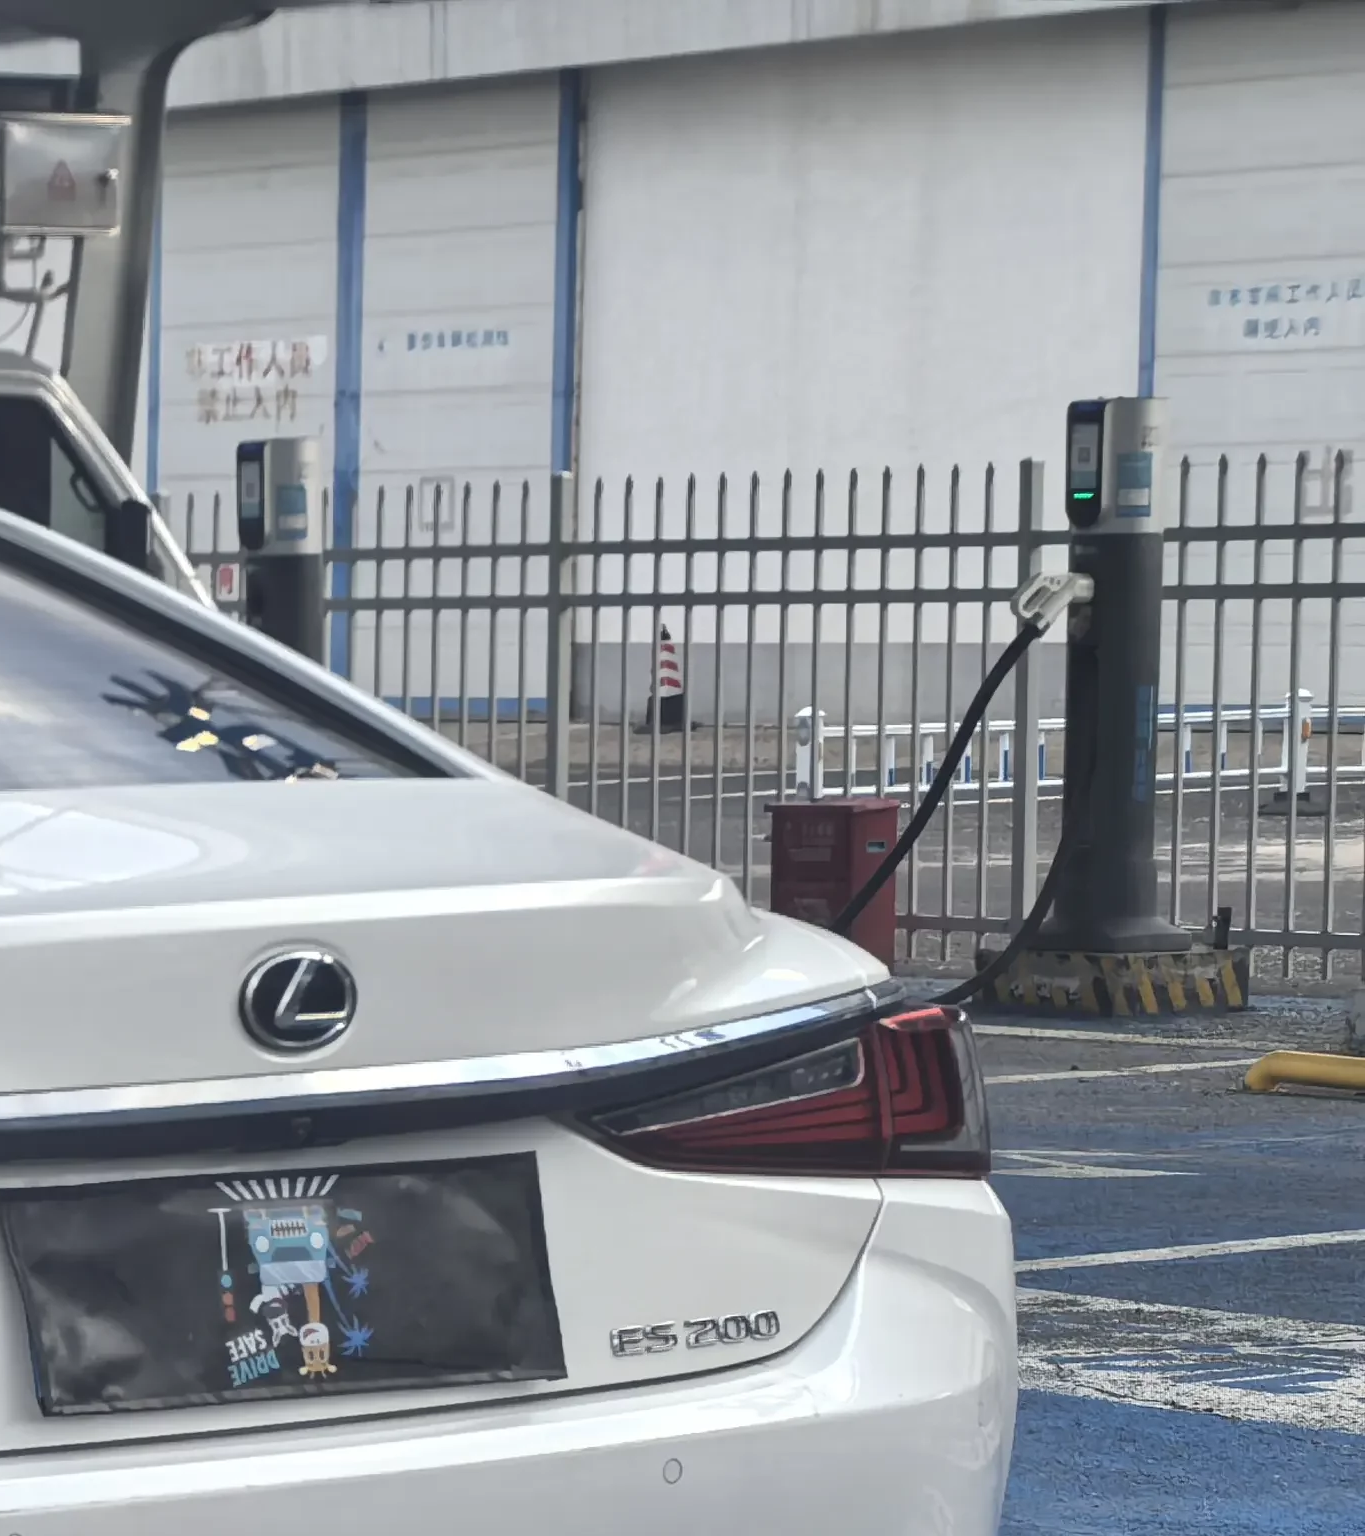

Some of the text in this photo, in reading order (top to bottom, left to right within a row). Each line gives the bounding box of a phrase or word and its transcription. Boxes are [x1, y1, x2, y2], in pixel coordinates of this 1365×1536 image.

[225, 1328, 268, 1363] SAFE
[610, 1309, 781, 1357] ES 200
[227, 1348, 280, 1389] DRIVE
